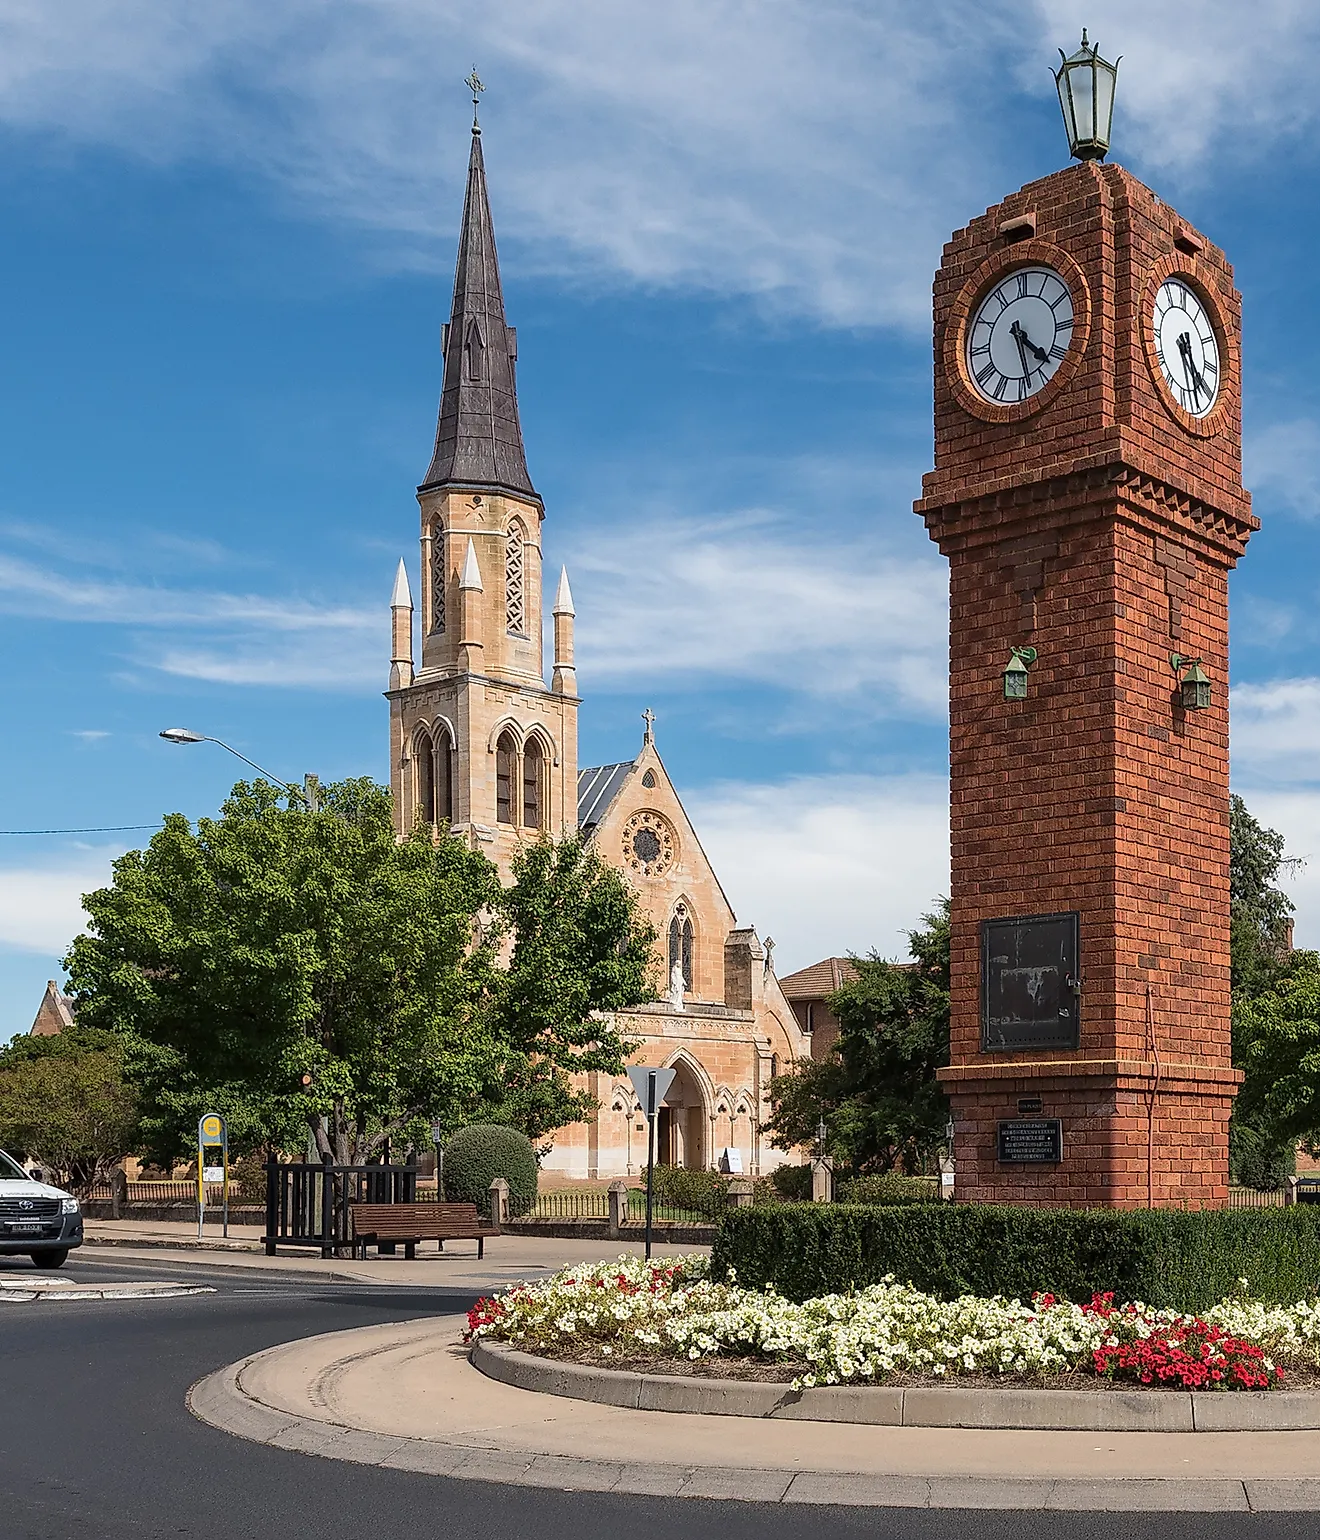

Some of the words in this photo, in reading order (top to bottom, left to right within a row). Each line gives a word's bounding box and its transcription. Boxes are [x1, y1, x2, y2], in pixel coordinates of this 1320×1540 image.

[1017, 274, 1027, 298] XII
[993, 288, 1008, 310] XI
[1050, 290, 1069, 310] II
[977, 316, 994, 328] X
[1056, 319, 1074, 332] III
[976, 362, 996, 388] VIII
[993, 376, 1008, 400] VII
